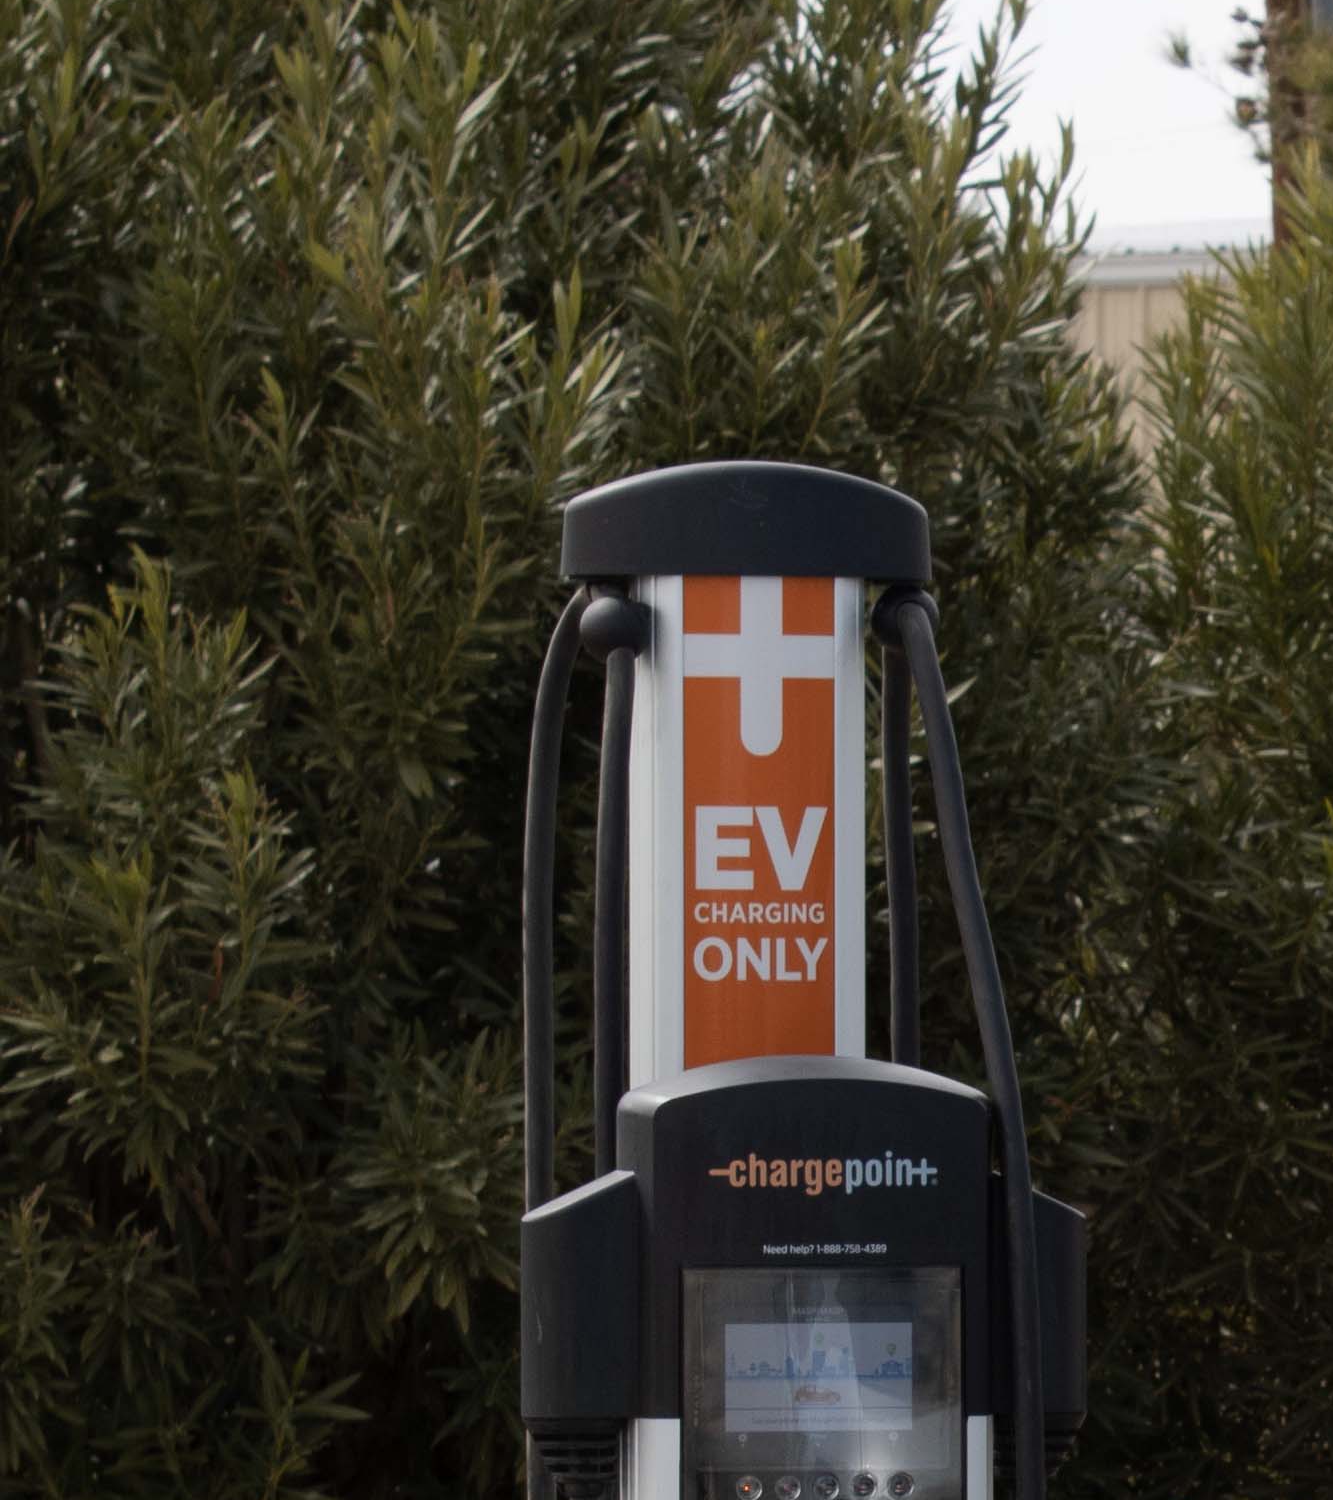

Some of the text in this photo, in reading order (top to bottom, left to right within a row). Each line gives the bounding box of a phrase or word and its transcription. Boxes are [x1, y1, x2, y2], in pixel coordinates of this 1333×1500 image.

[695, 805, 828, 891] EV
[694, 902, 825, 924] CHARGING
[693, 936, 828, 981] ONLY
[762, 1243, 788, 1255] Need
[789, 1243, 815, 1256] help?
